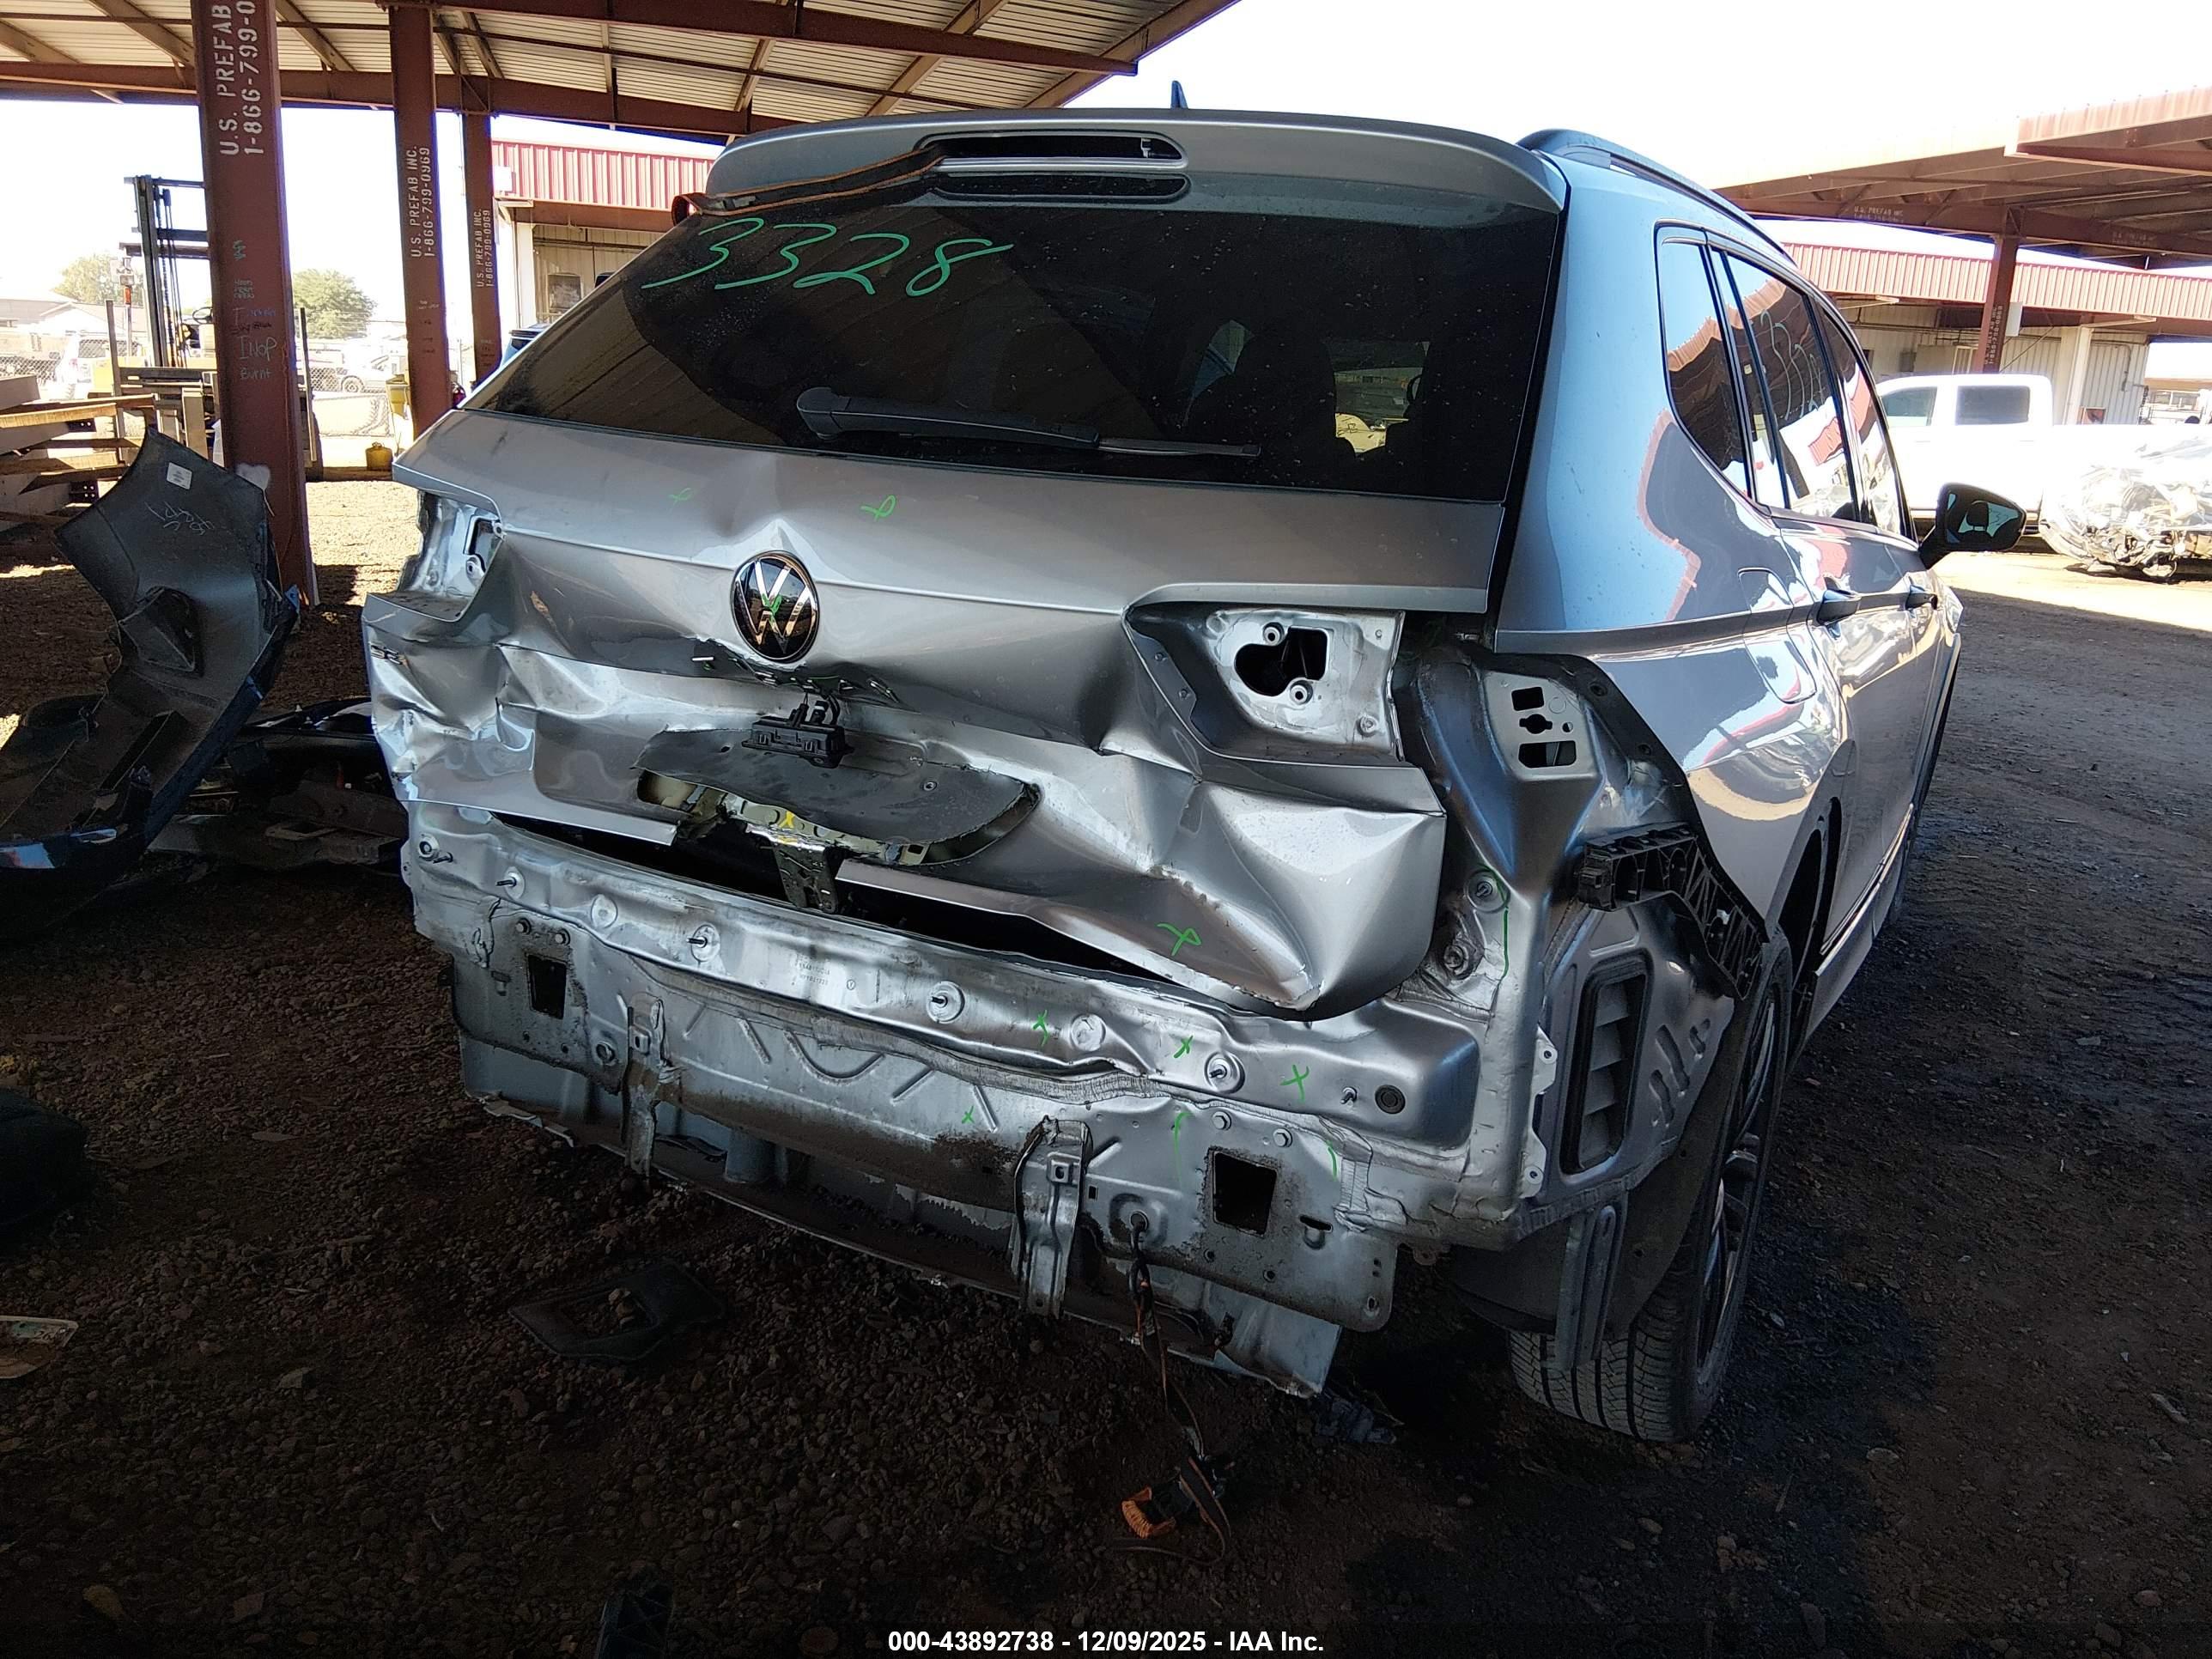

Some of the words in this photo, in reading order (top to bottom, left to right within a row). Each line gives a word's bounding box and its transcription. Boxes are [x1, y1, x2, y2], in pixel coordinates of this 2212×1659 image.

[211, 4, 236, 97] PREFAB
[218, 112, 240, 155] U.S.
[405, 145, 418, 170] INC.
[407, 176, 421, 227] PREFAB
[418, 147, 435, 257] 1-866-799-0969
[410, 232, 422, 258] U.S.
[641, 217, 1015, 296] 3328
